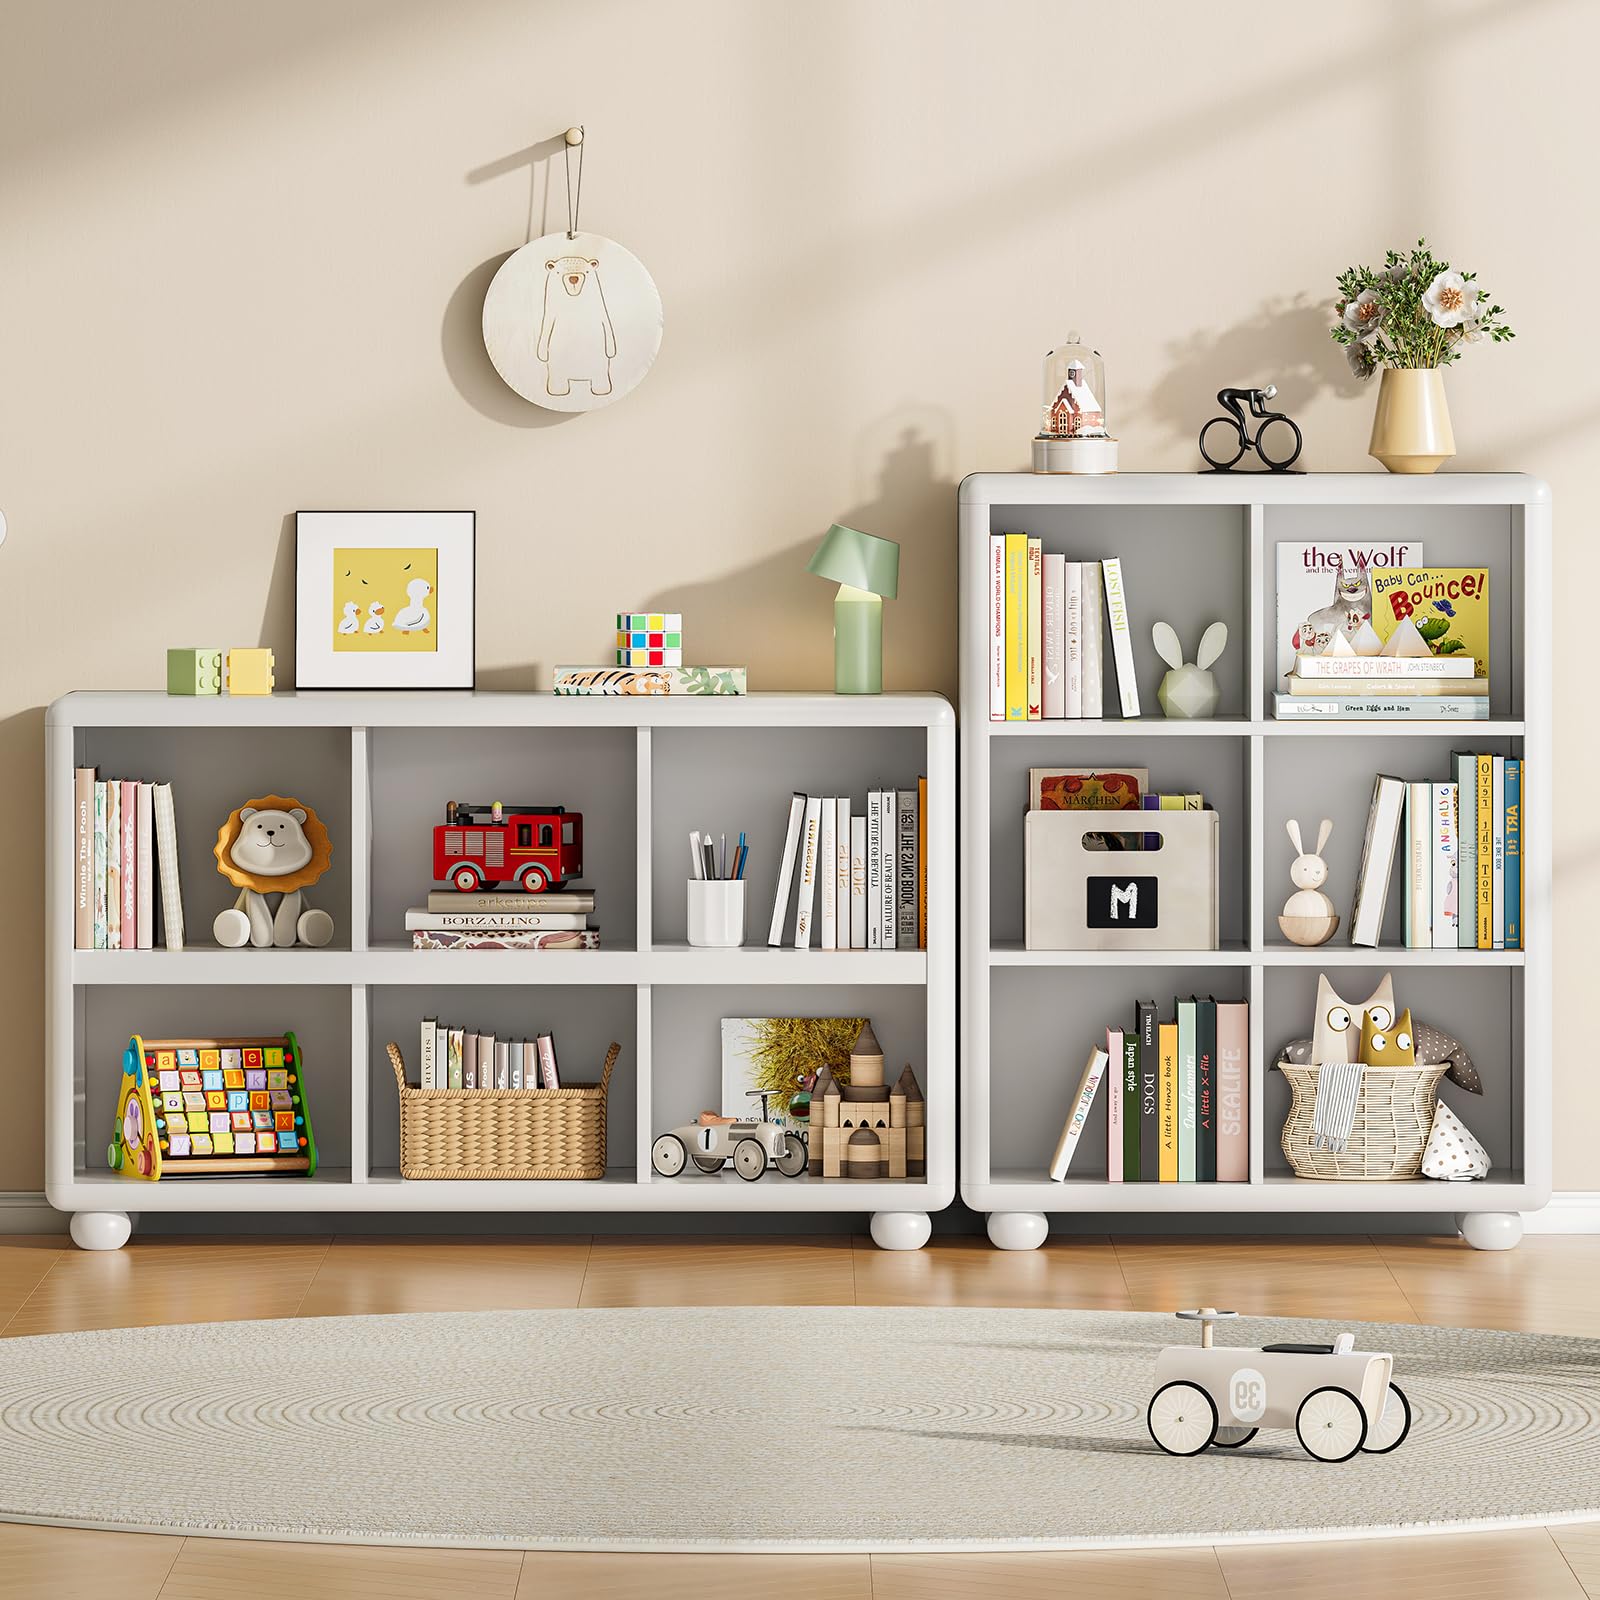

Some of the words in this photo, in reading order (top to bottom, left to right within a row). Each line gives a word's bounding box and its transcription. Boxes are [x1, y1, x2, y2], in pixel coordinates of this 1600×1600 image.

[1302, 546, 1340, 567] the
[1348, 546, 1408, 567] Wolf
[1375, 574, 1402, 593] Baby
[1389, 573, 1485, 621] Bounce!
[1316, 662, 1332, 674] THE
[1332, 662, 1361, 674] GRAPES
[1363, 662, 1374, 674] OF
[1376, 662, 1402, 674] WRATH
[1407, 663, 1420, 672] JOHN
[1420, 663, 1446, 672] STEINBECK
[1366, 704, 1382, 712] Eggs
[885, 853, 893, 882] BEAUTY
[885, 884, 893, 894] OF
[885, 894, 893, 923] ALLURE
[1110, 882, 1138, 920] M
[442, 917, 541, 926] BORZALINO
[885, 924, 893, 940] THE
[162, 1056, 170, 1065] a
[205, 1056, 213, 1064] c
[248, 1054, 256, 1063] e
[1126, 1042, 1137, 1068] Japan
[1164, 1056, 1172, 1078] book
[1200, 1054, 1210, 1086] X-file
[1126, 1070, 1138, 1092] style
[1222, 1048, 1240, 1136] SEALIFE
[235, 1096, 243, 1108] p
[1144, 1074, 1154, 1115] DOGS
[1164, 1082, 1172, 1110] Honzo
[1201, 1090, 1210, 1115] little
[1164, 1114, 1172, 1138] little
[1202, 1120, 1210, 1128] A
[704, 1128, 710, 1150] 1
[1165, 1142, 1172, 1150] A
